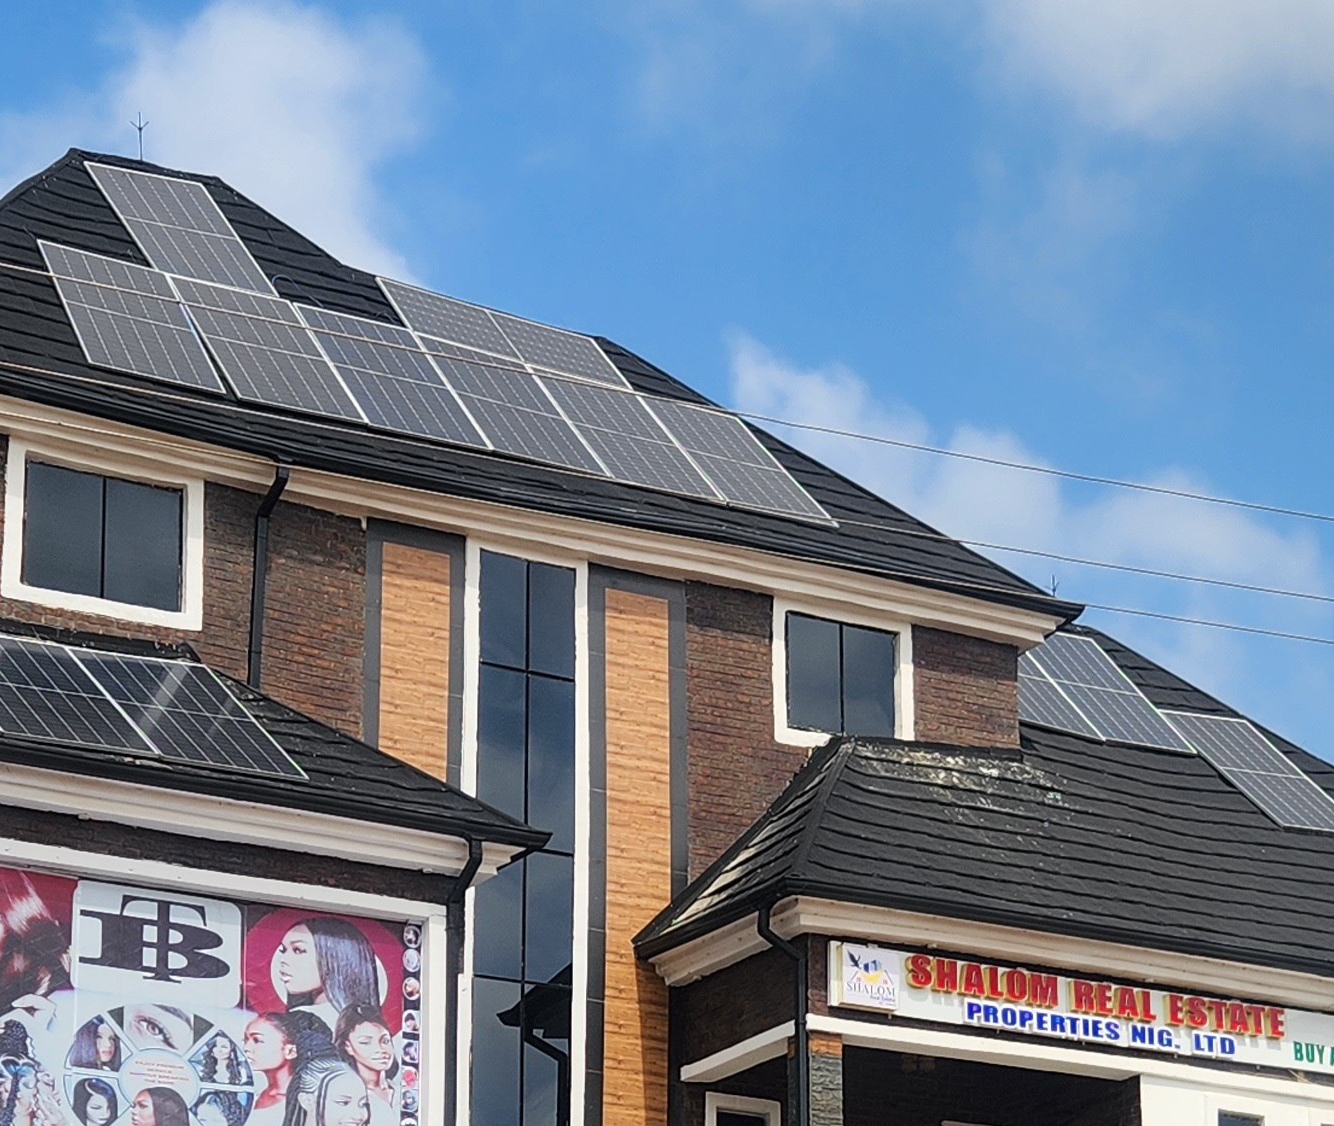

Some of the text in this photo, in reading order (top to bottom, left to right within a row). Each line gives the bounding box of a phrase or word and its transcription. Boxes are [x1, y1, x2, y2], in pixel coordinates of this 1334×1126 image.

[847, 981, 896, 997] SHALOM
[907, 954, 1285, 1039] SHALOM REAL ESTATE
[966, 1001, 1236, 1056] PROPERTIES NIG. LTD
[1293, 1040, 1326, 1065] BUY
